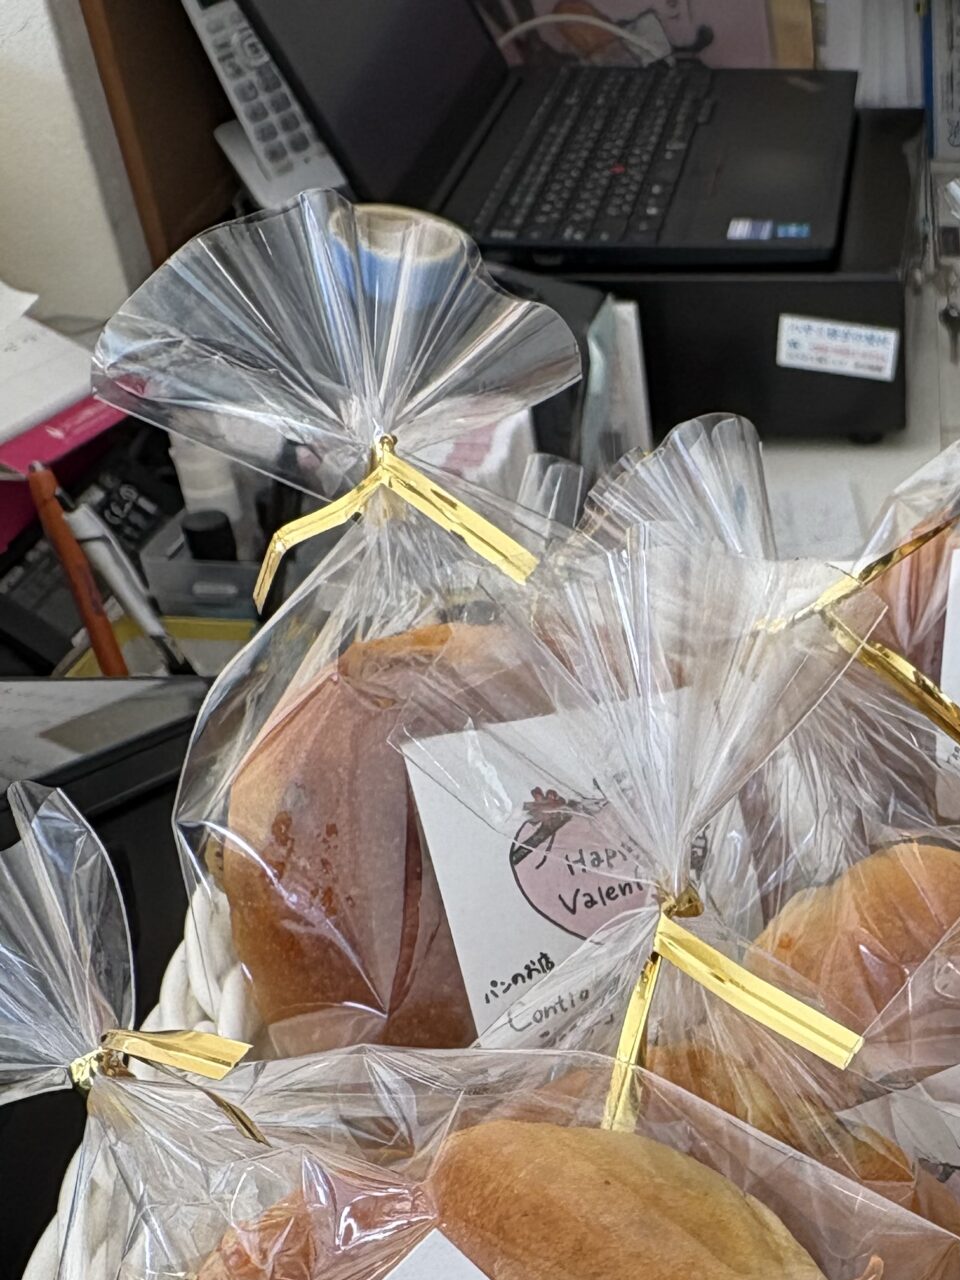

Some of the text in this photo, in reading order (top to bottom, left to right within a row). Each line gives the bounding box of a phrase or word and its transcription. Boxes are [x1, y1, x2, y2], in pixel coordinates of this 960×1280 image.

[484, 951, 556, 1004] パンのお店
